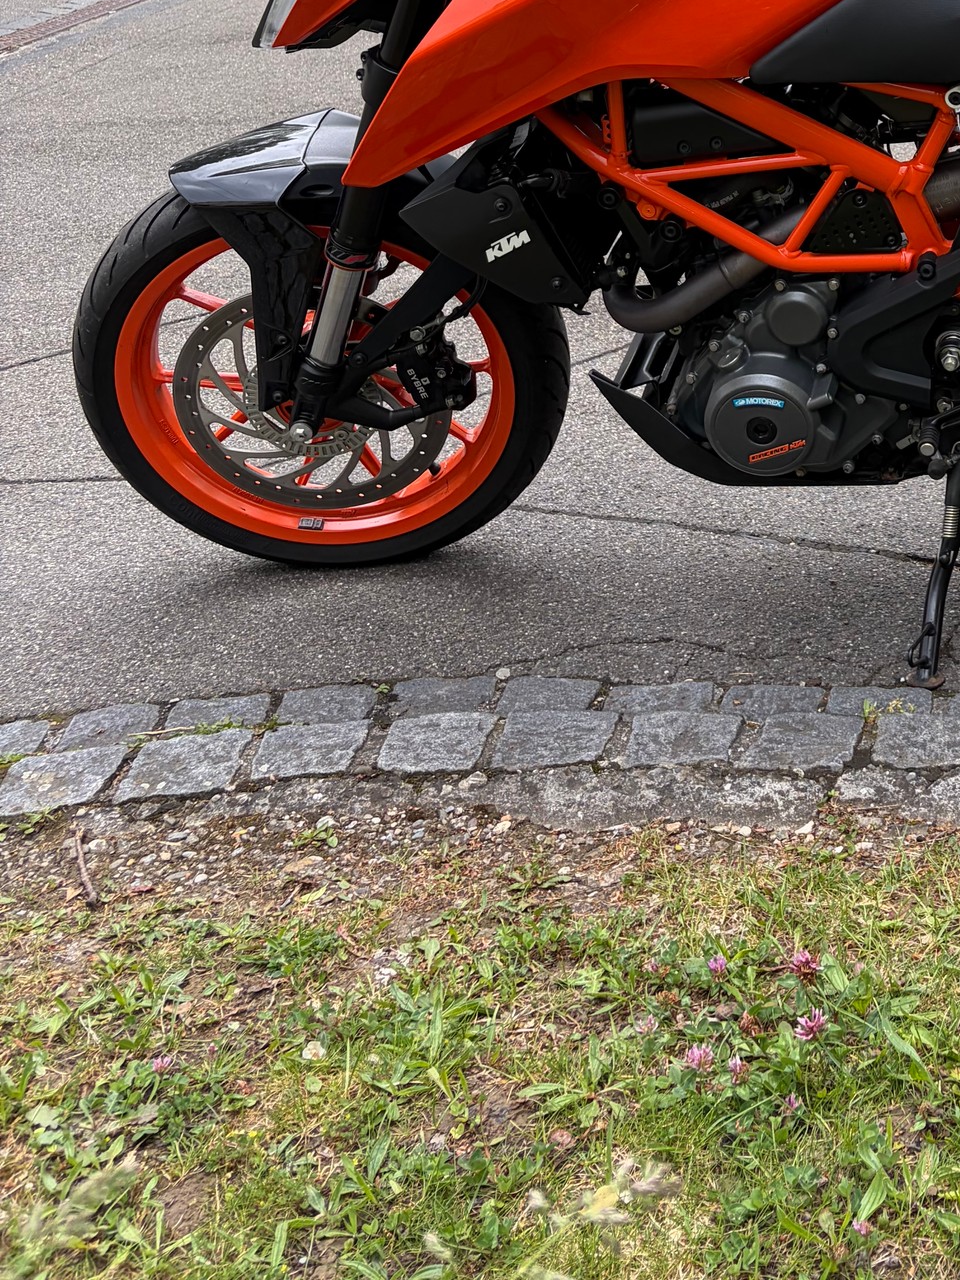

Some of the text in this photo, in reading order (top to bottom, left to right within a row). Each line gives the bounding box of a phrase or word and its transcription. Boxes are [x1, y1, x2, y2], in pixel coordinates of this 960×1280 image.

[485, 229, 531, 263] KTM
[406, 368, 429, 399] BYBRE
[745, 397, 783, 408] MOTOREX
